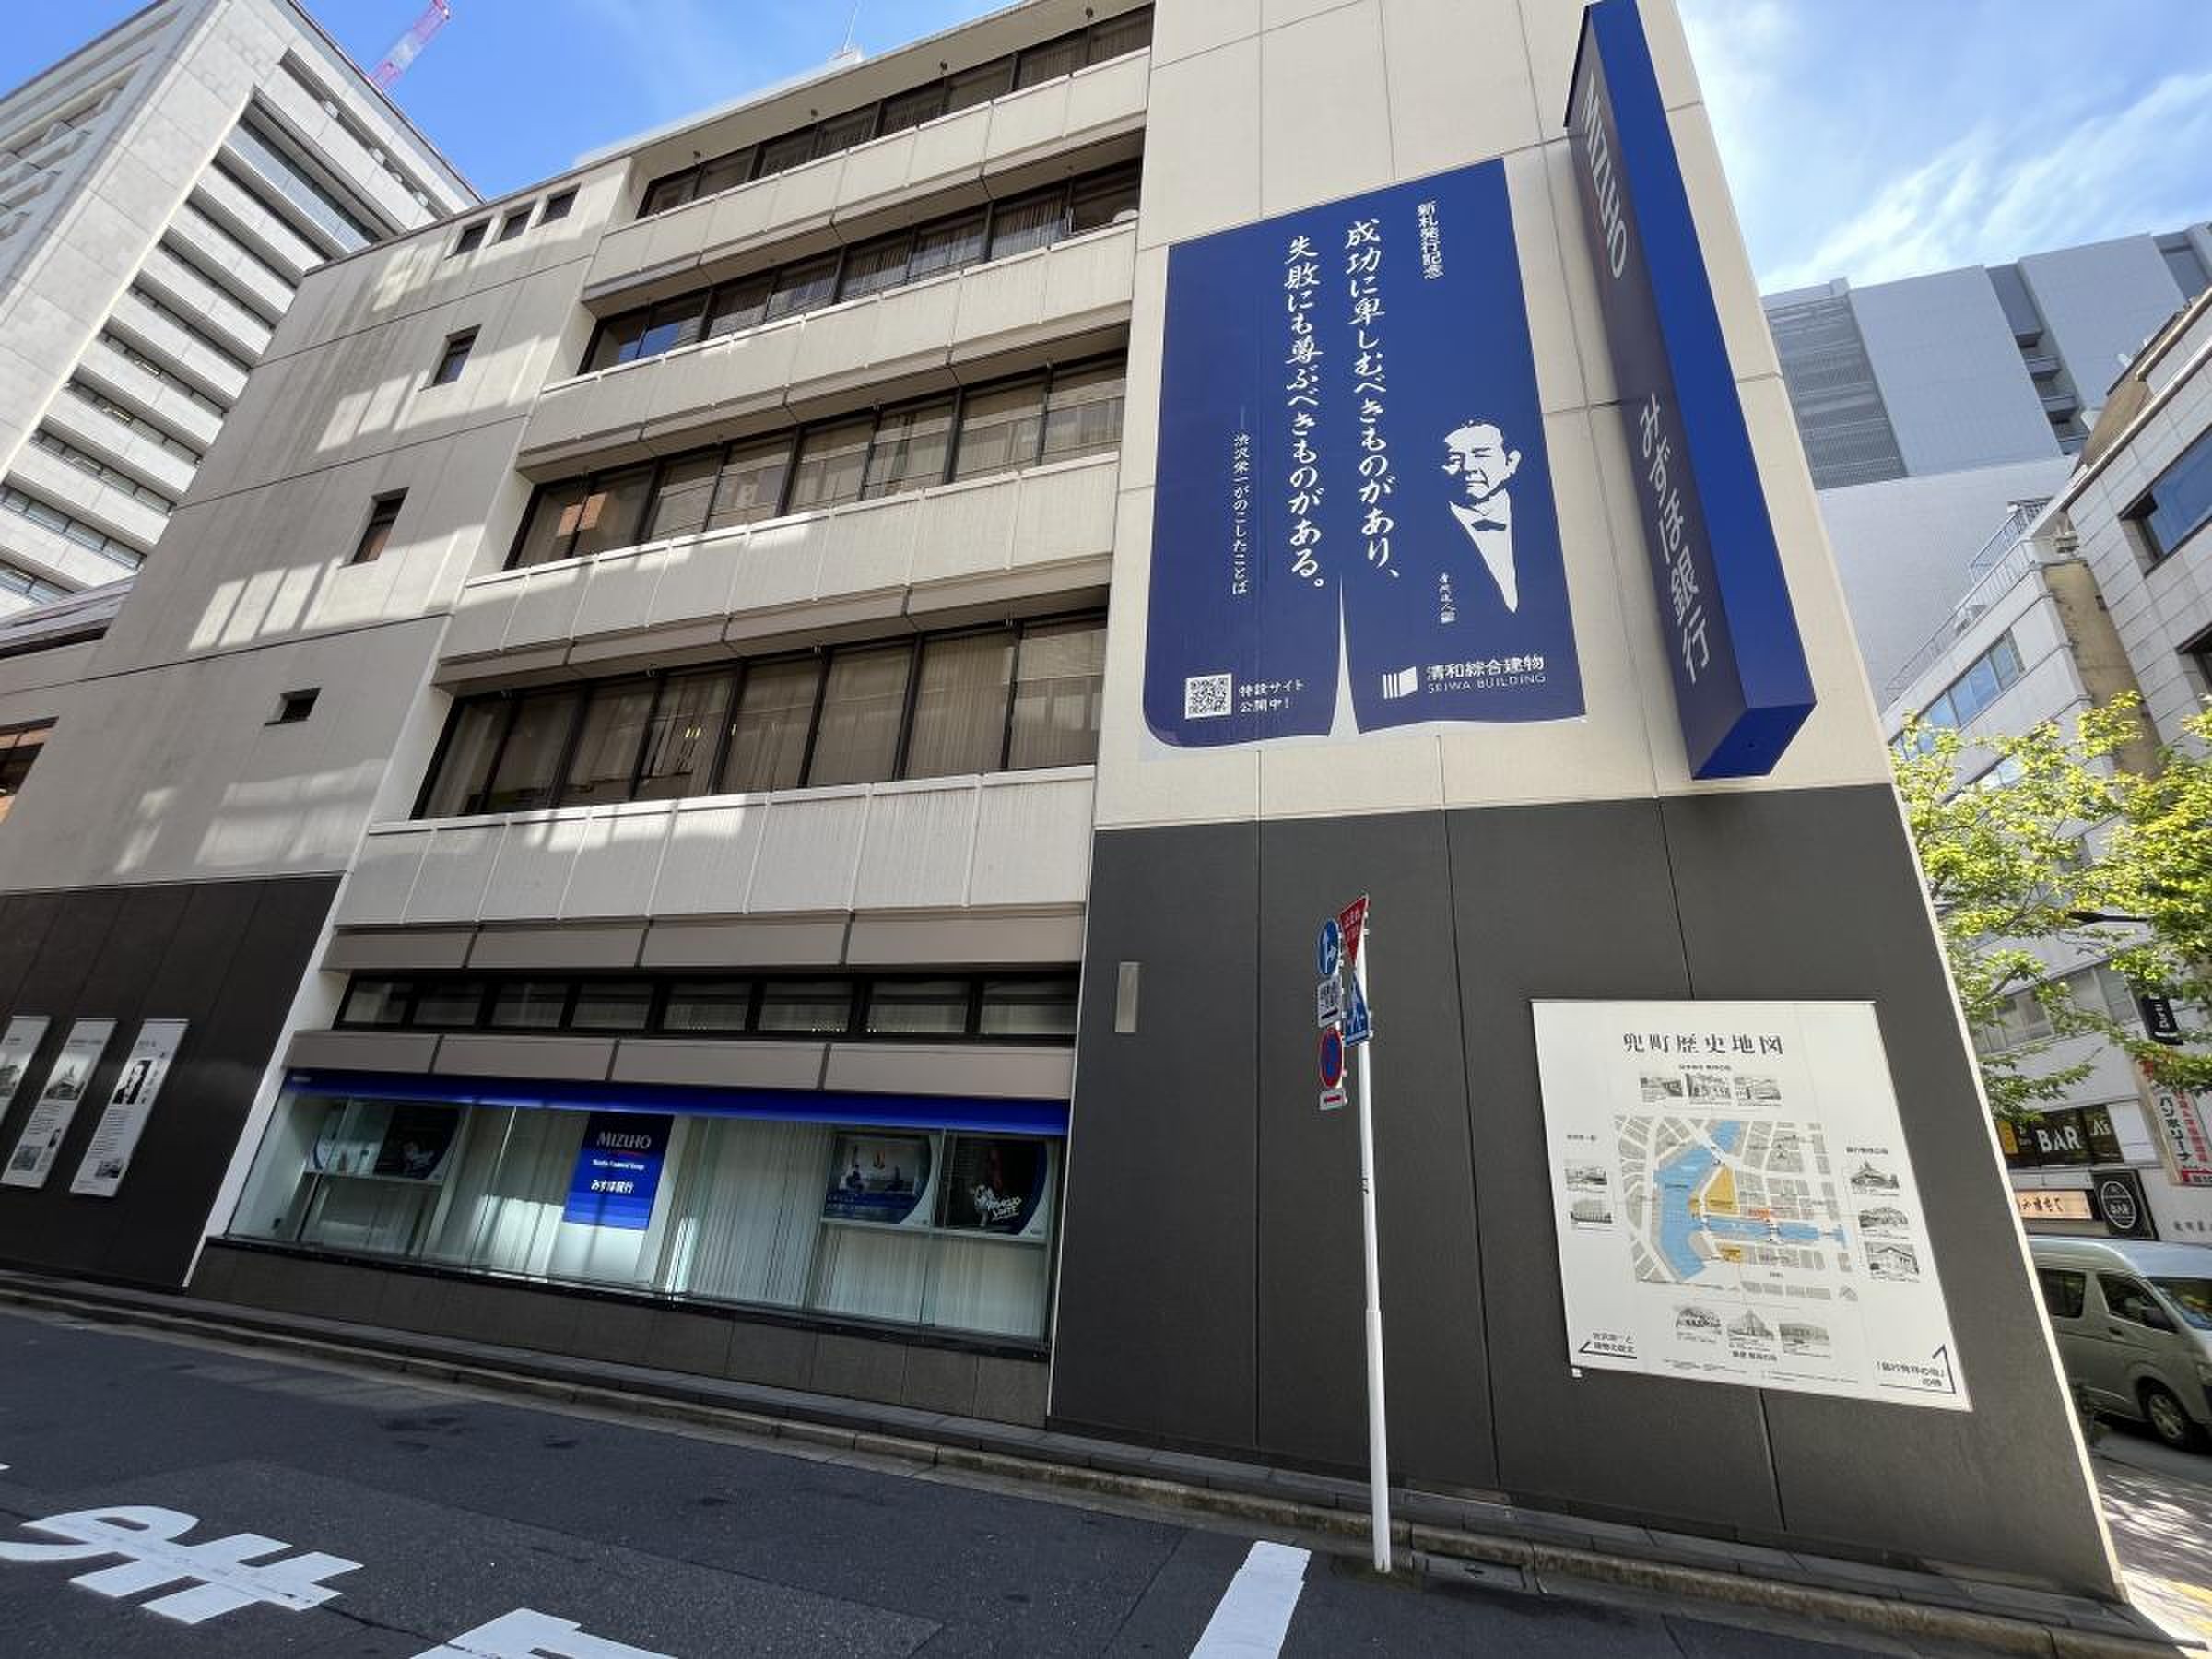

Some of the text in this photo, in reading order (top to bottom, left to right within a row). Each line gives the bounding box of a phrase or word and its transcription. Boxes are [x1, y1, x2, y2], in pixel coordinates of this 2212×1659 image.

[1581, 71, 1628, 279] MIZUHO
[1418, 200, 1444, 280] 新札発行記念
[1284, 235, 1326, 589] 失敗にも尊ぶべきものがある。
[1344, 218, 1400, 578] 成功に卑しむべきものがあり、
[1640, 392, 1710, 685] みずほ銀行
[1427, 654, 1545, 680] 清和綜合建物
[1238, 679, 1304, 697] 特設サイト
[1428, 674, 1546, 693] SEIWA BUILDING
[1623, 1033, 1783, 1055] 兜町歴史地図
[596, 1131, 652, 1150] MIZUHO
[2036, 1125, 2082, 1153] BAR
